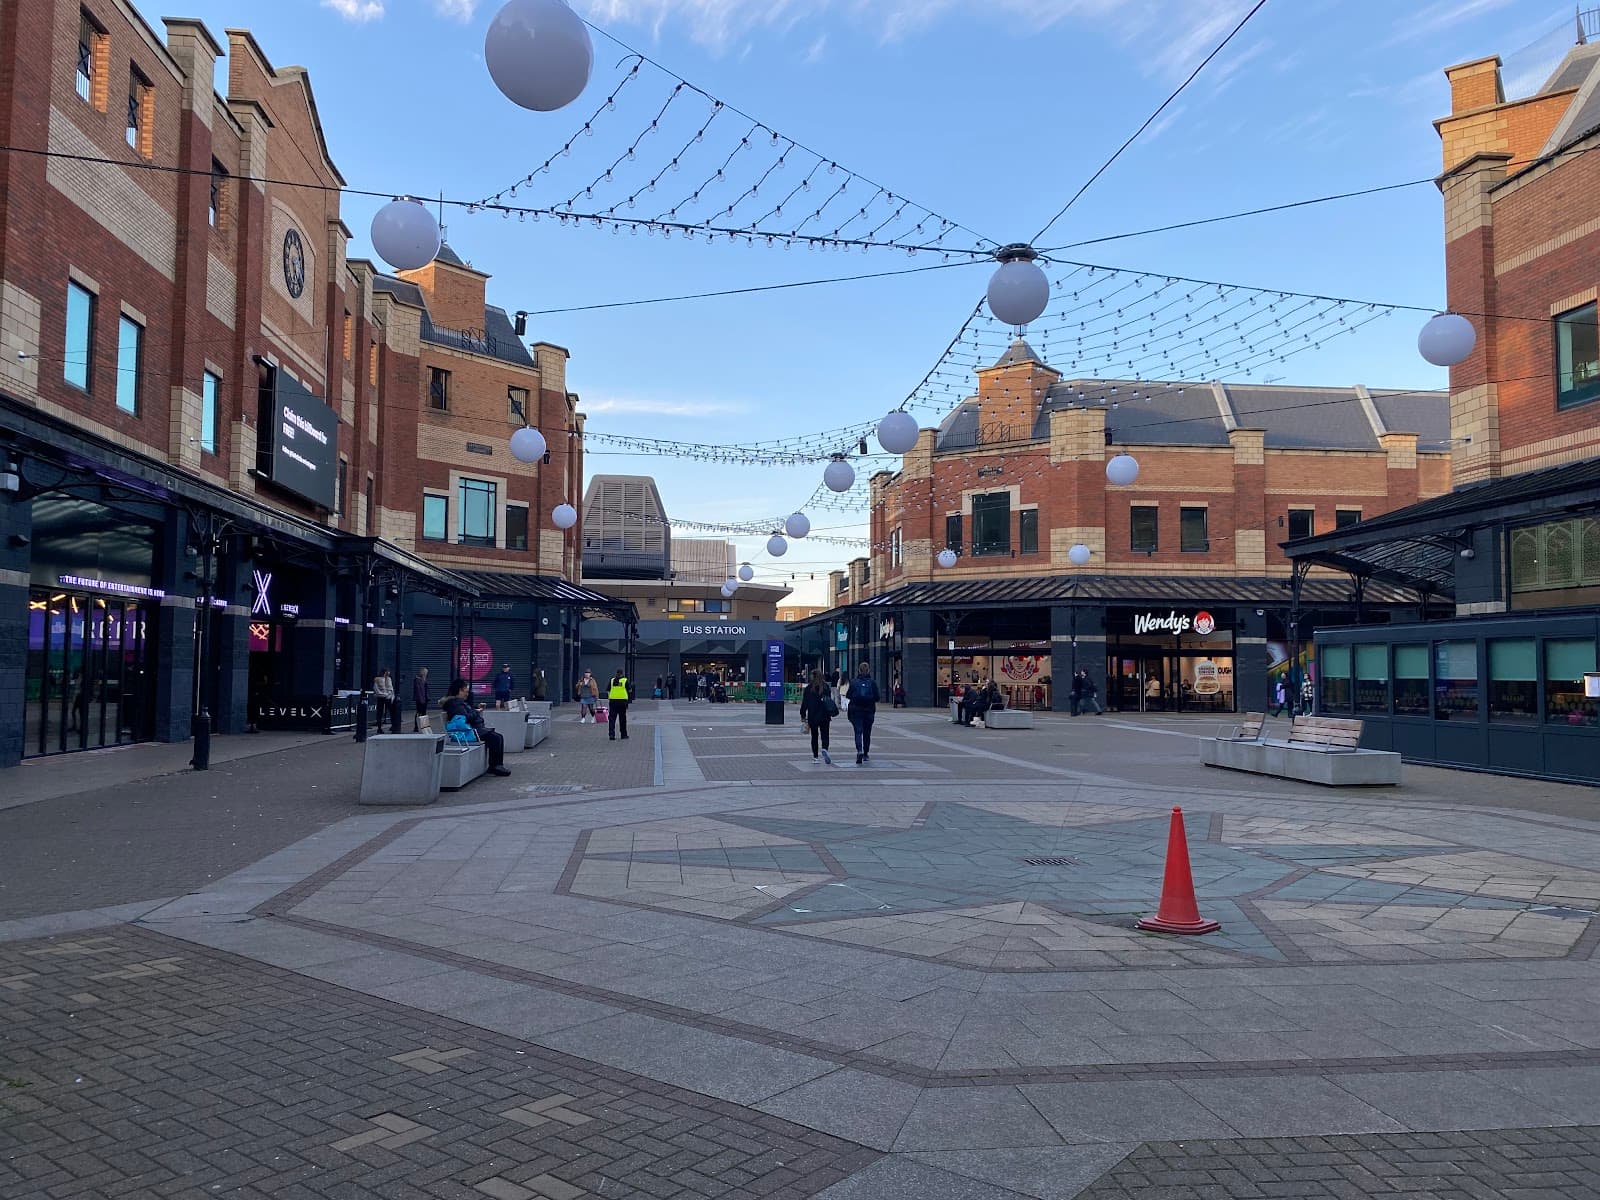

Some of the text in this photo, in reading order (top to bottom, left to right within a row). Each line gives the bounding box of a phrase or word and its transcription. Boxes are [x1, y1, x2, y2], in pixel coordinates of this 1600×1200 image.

[252, 569, 272, 615] X
[682, 625, 746, 635] BUS STATION
[1134, 610, 1190, 635] Wendy's
